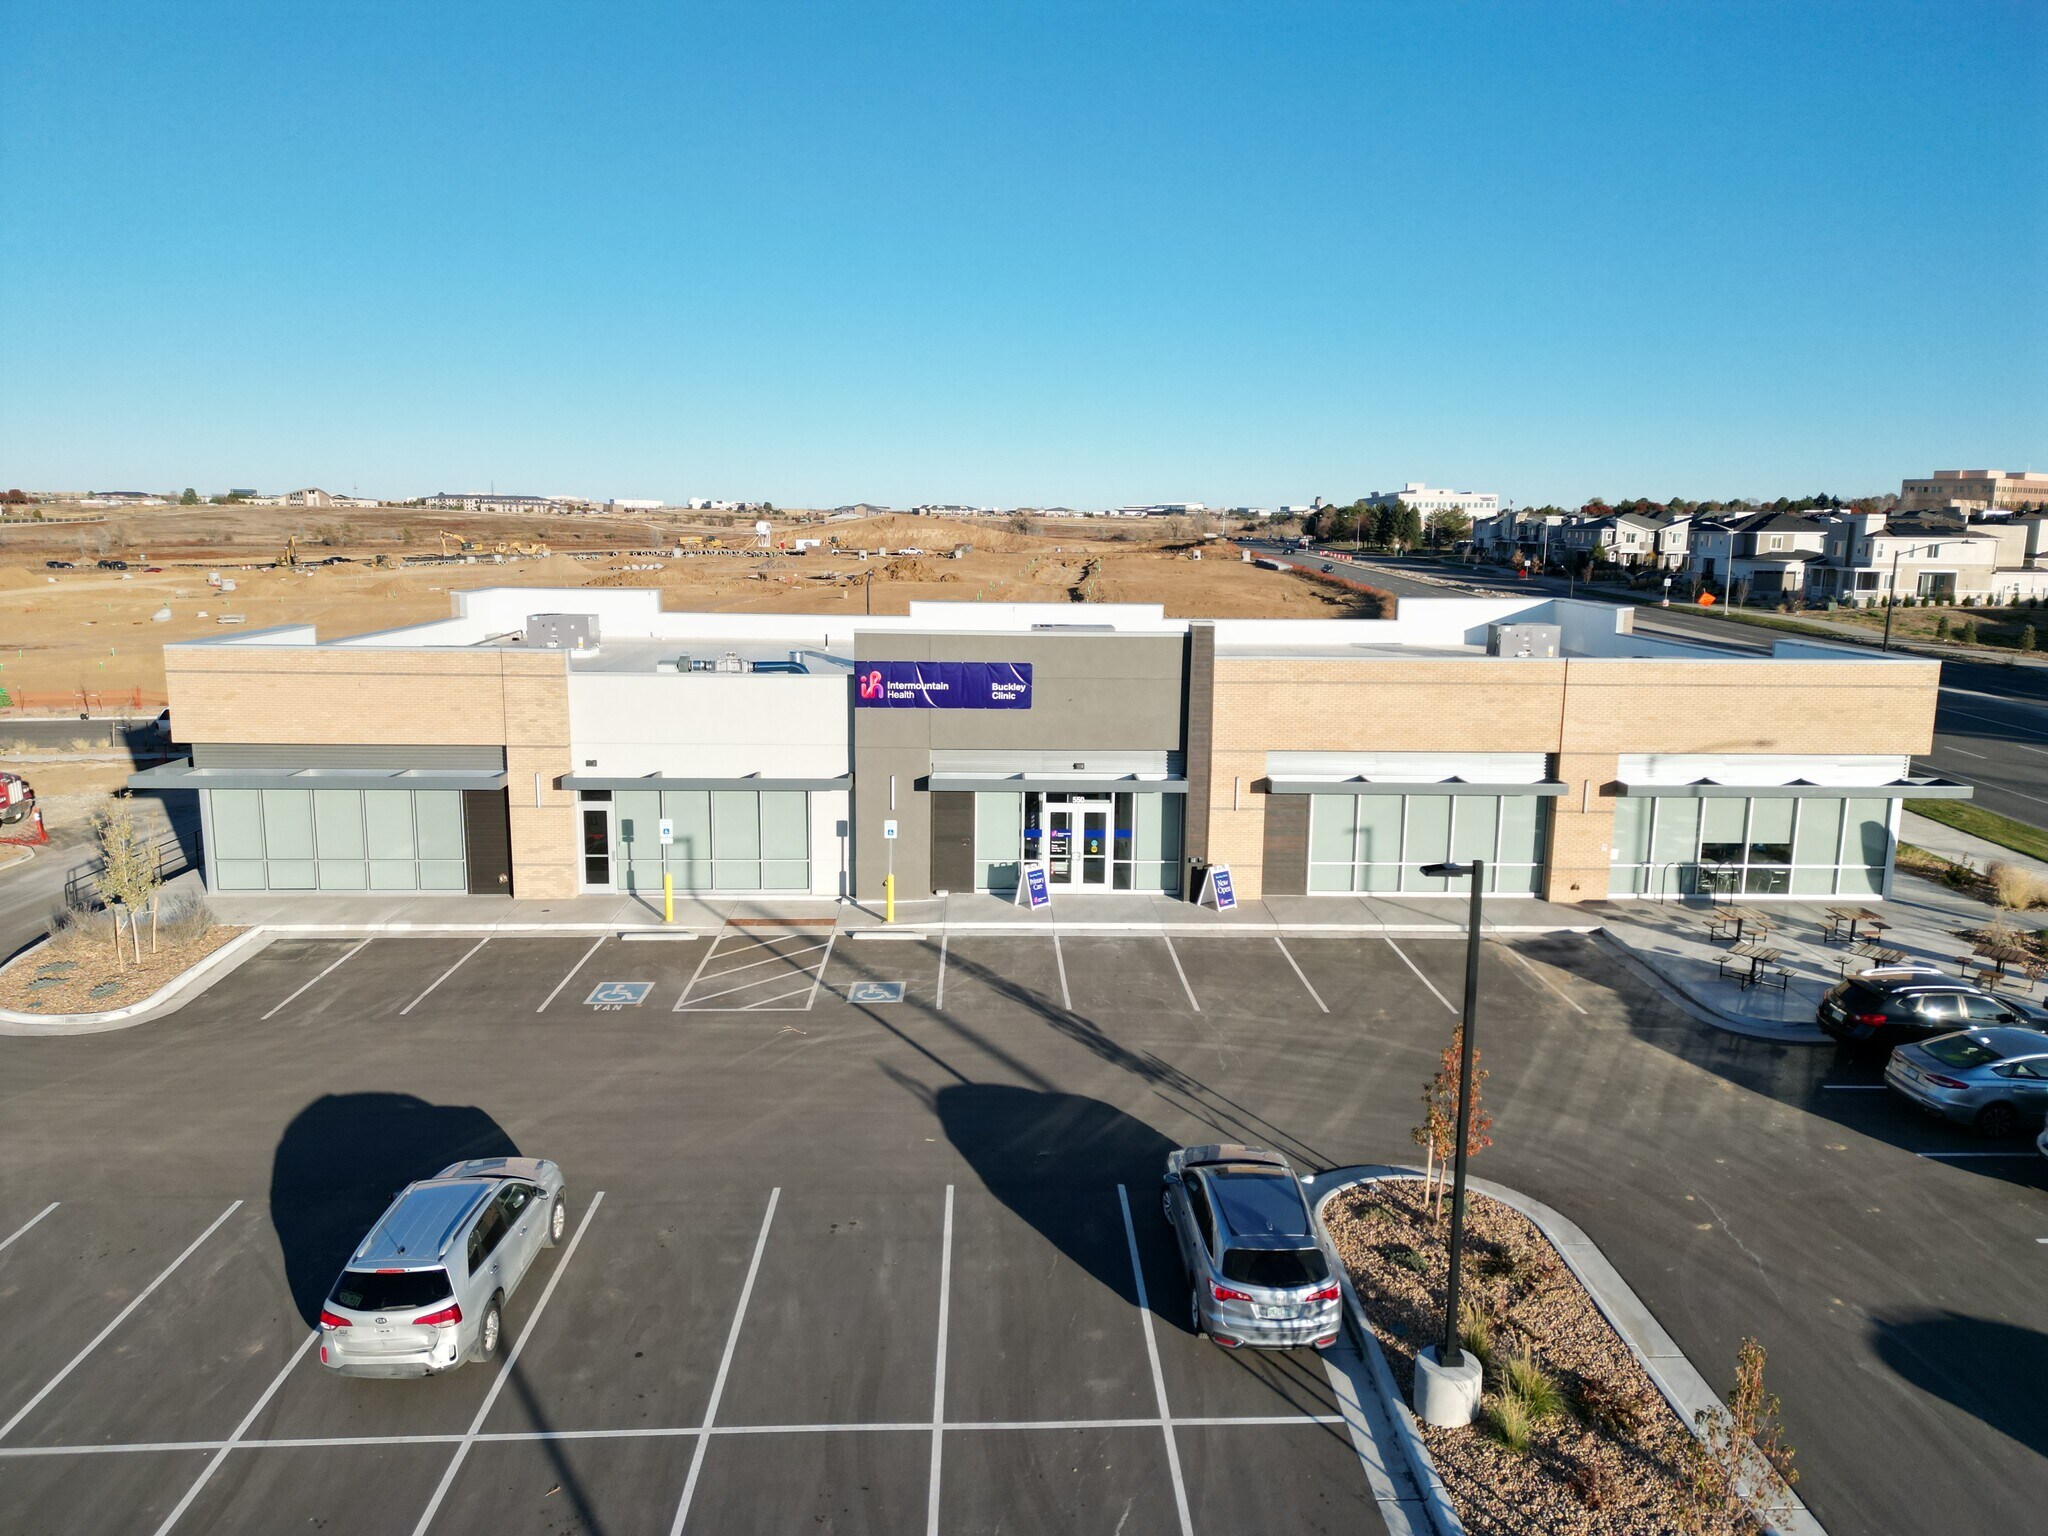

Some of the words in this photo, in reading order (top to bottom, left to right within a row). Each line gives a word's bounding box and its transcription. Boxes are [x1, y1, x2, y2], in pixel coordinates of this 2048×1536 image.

[887, 681, 949, 690] Intermountain
[992, 683, 1026, 692] Buckley
[887, 691, 915, 699] Health
[1217, 886, 1231, 894] Open
